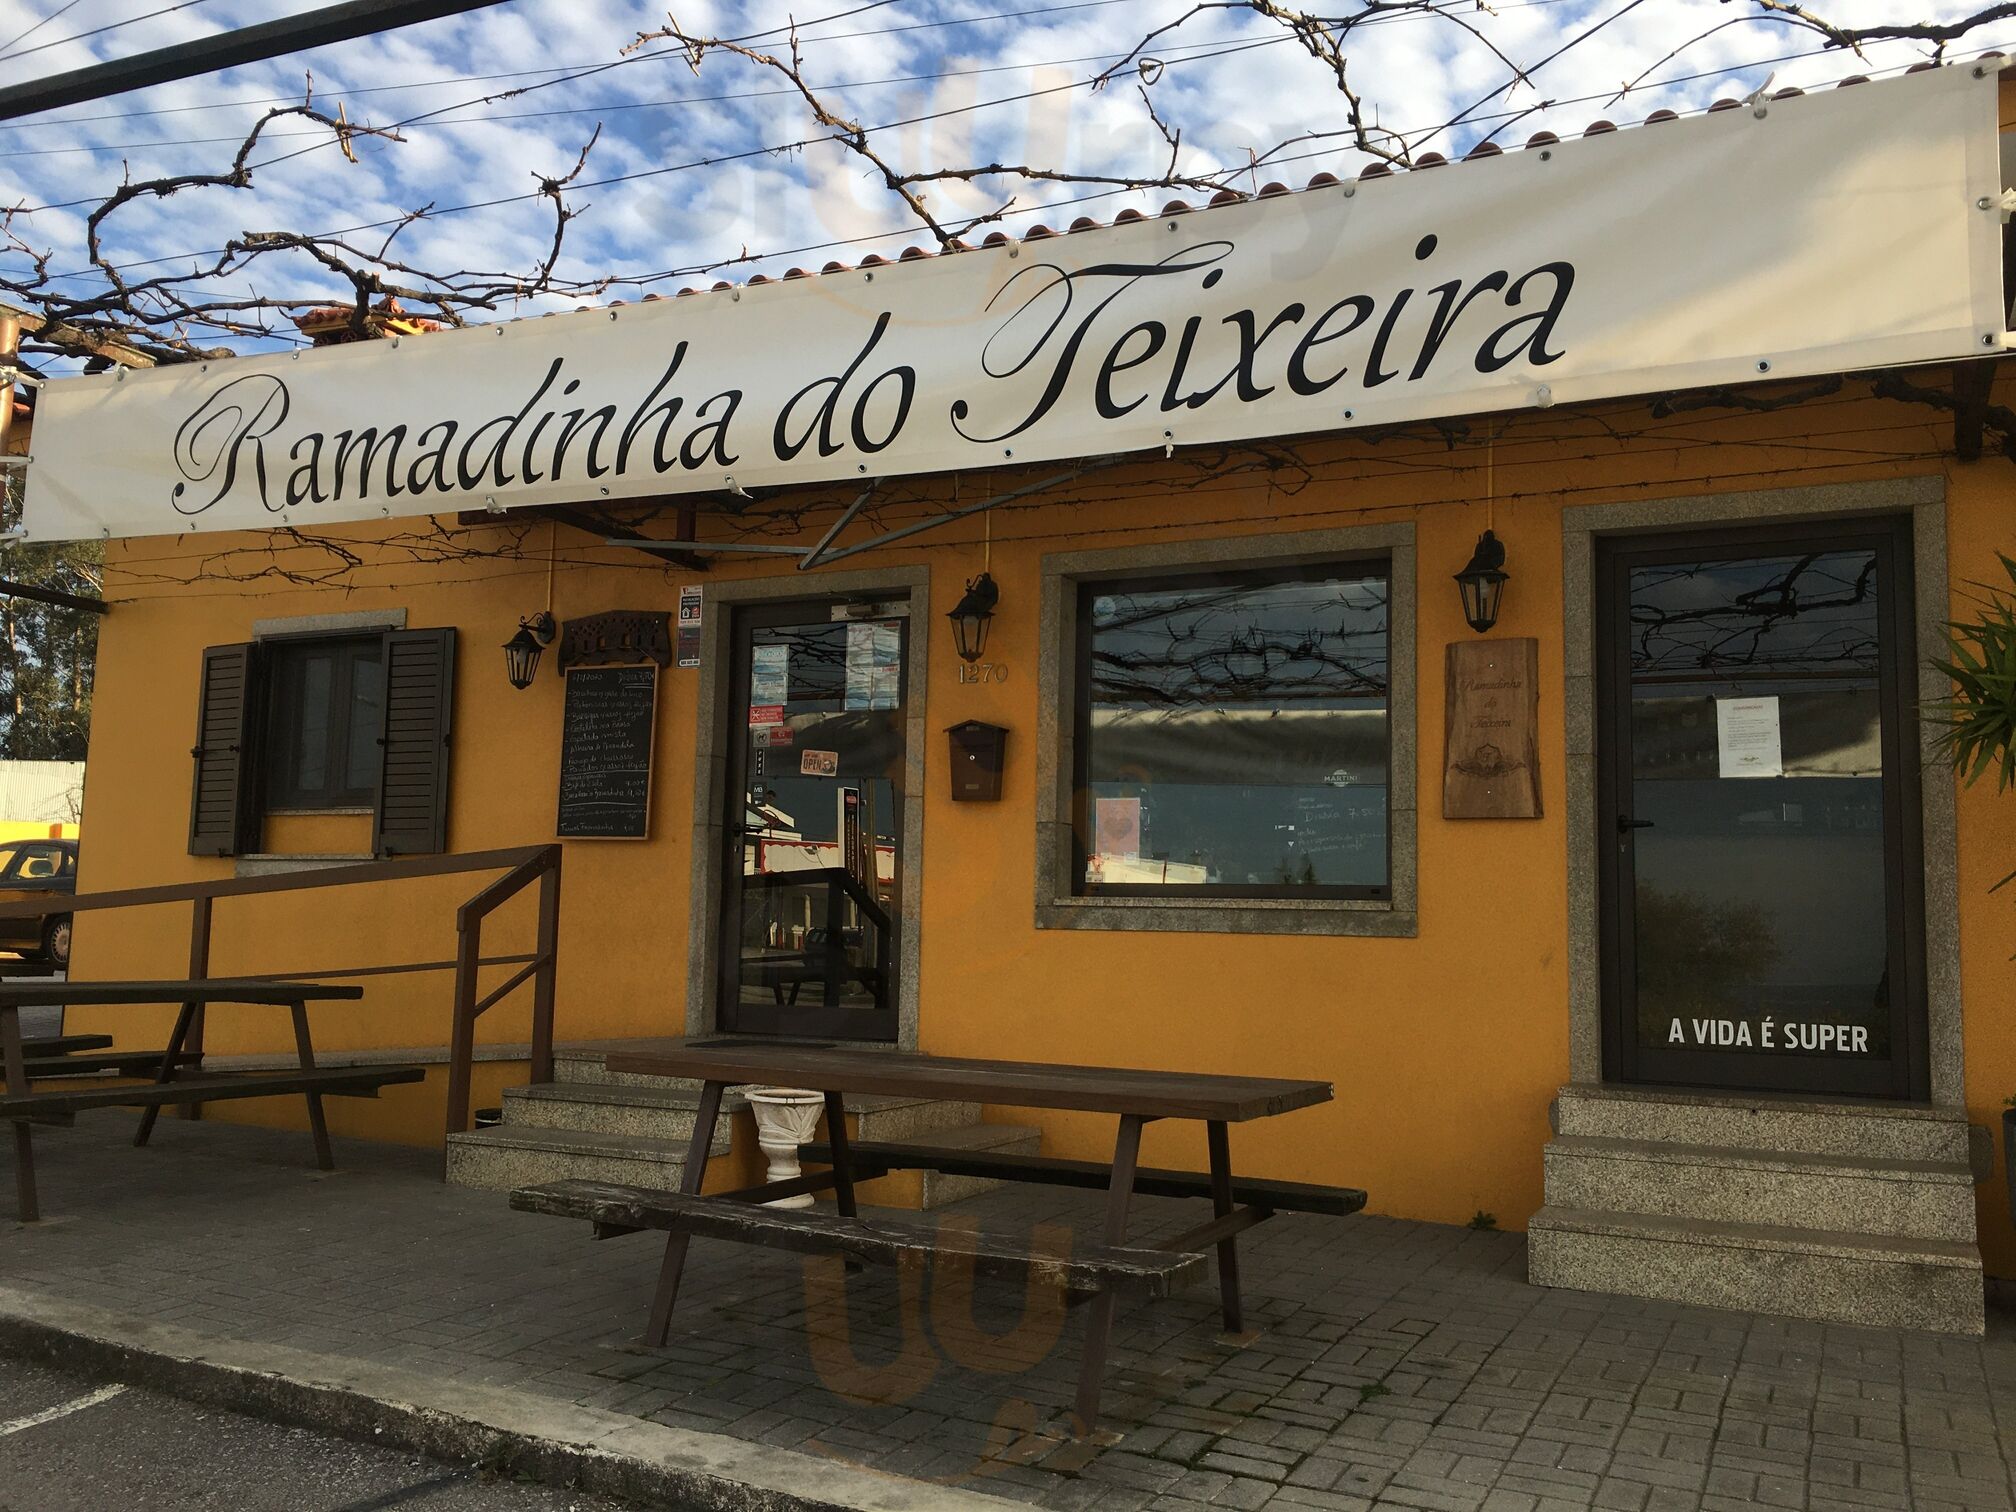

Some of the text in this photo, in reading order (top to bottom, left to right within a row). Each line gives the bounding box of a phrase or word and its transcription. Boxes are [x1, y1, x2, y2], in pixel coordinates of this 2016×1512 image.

[172, 234, 1574, 514] Ramadinha do Teixeira
[960, 663, 1009, 684] 1270
[803, 759, 822, 770] OPEN
[1669, 1015, 1868, 1053] A VIDA É SUPER
